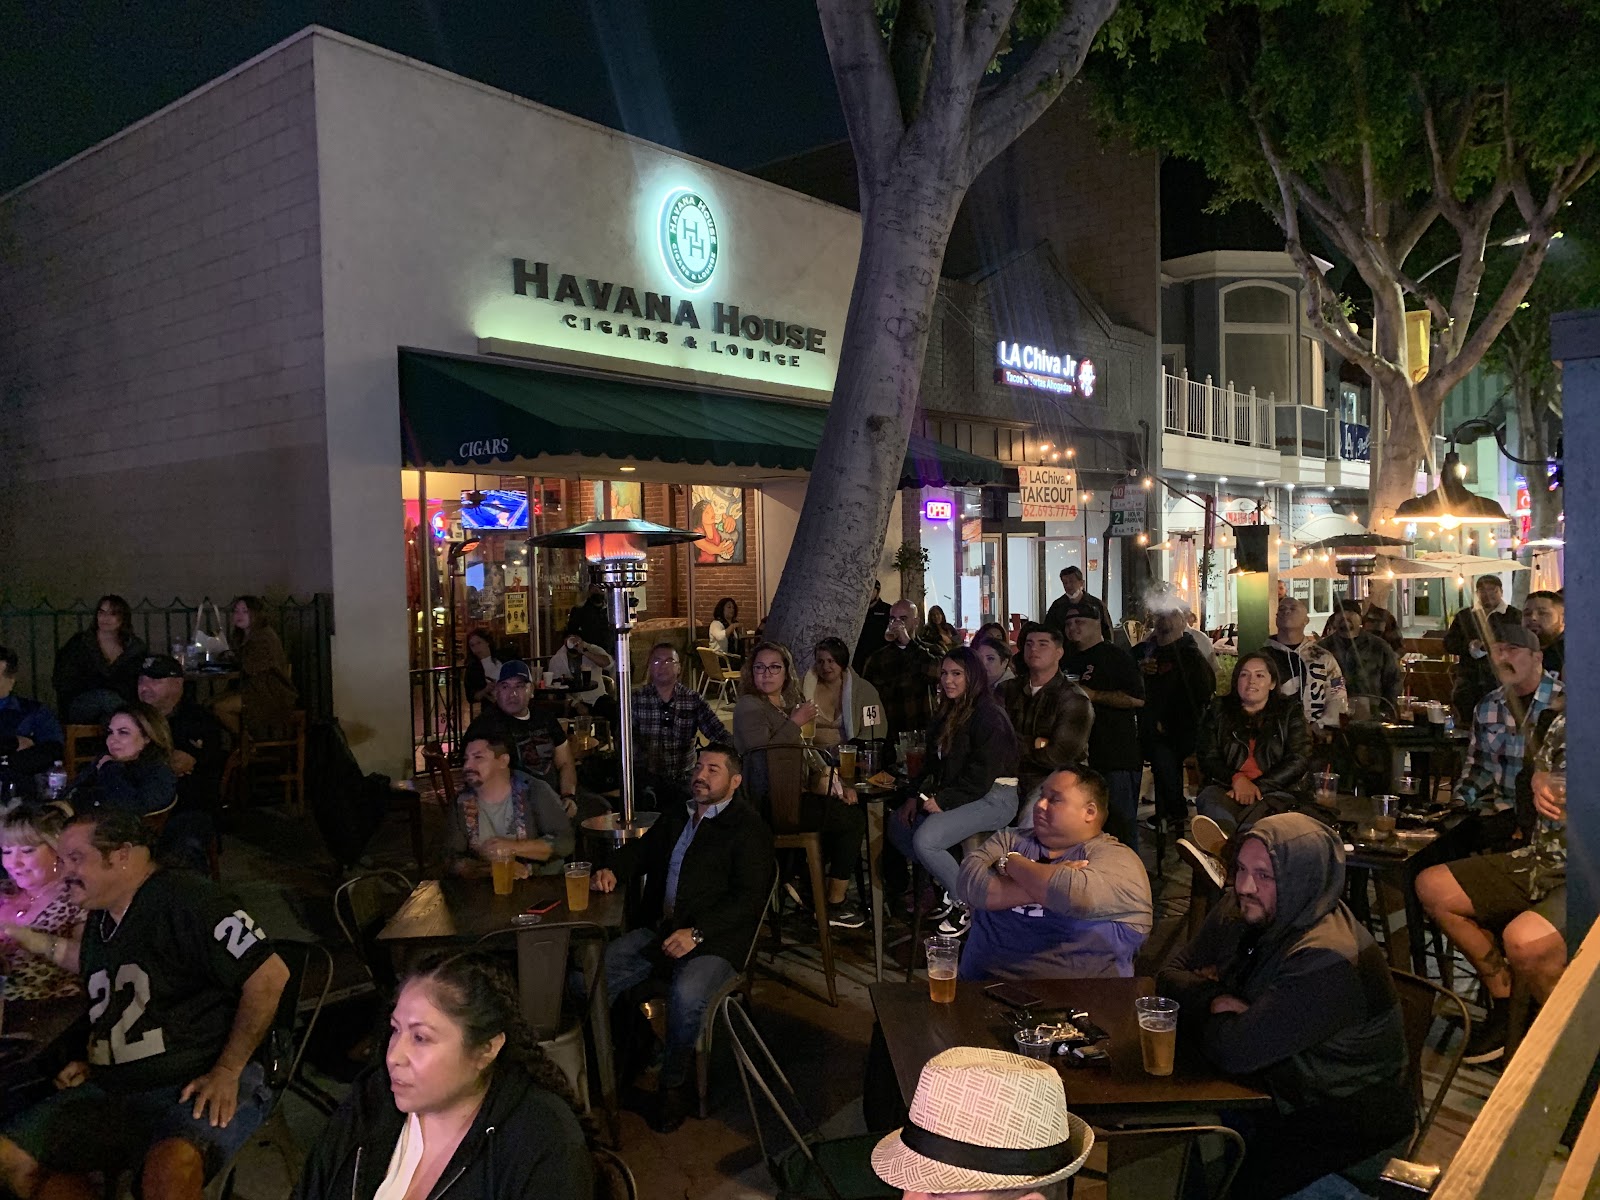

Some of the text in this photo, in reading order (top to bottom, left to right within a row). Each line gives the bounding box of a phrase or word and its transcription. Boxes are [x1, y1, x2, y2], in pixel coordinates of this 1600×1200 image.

[670, 196, 717, 245] HAVANA HOUSE
[671, 243, 690, 277] CIGARS
[698, 252, 716, 280] LOUNGE
[512, 258, 827, 355] HAVANA HOUSE
[560, 313, 800, 367] CIGARS & LOUNGE
[1063, 354, 1078, 377] Jr
[1005, 371, 1023, 384] Tacos
[459, 438, 509, 458] CIGARS
[1020, 486, 1073, 503] TAKEOUT
[1113, 487, 1124, 498] NO
[928, 503, 951, 518] OPEN
[1114, 512, 1121, 523] 2
[514, 610, 519, 620] 6
[866, 706, 877, 719] 45
[213, 909, 267, 960] 22
[87, 963, 166, 1066] 22
